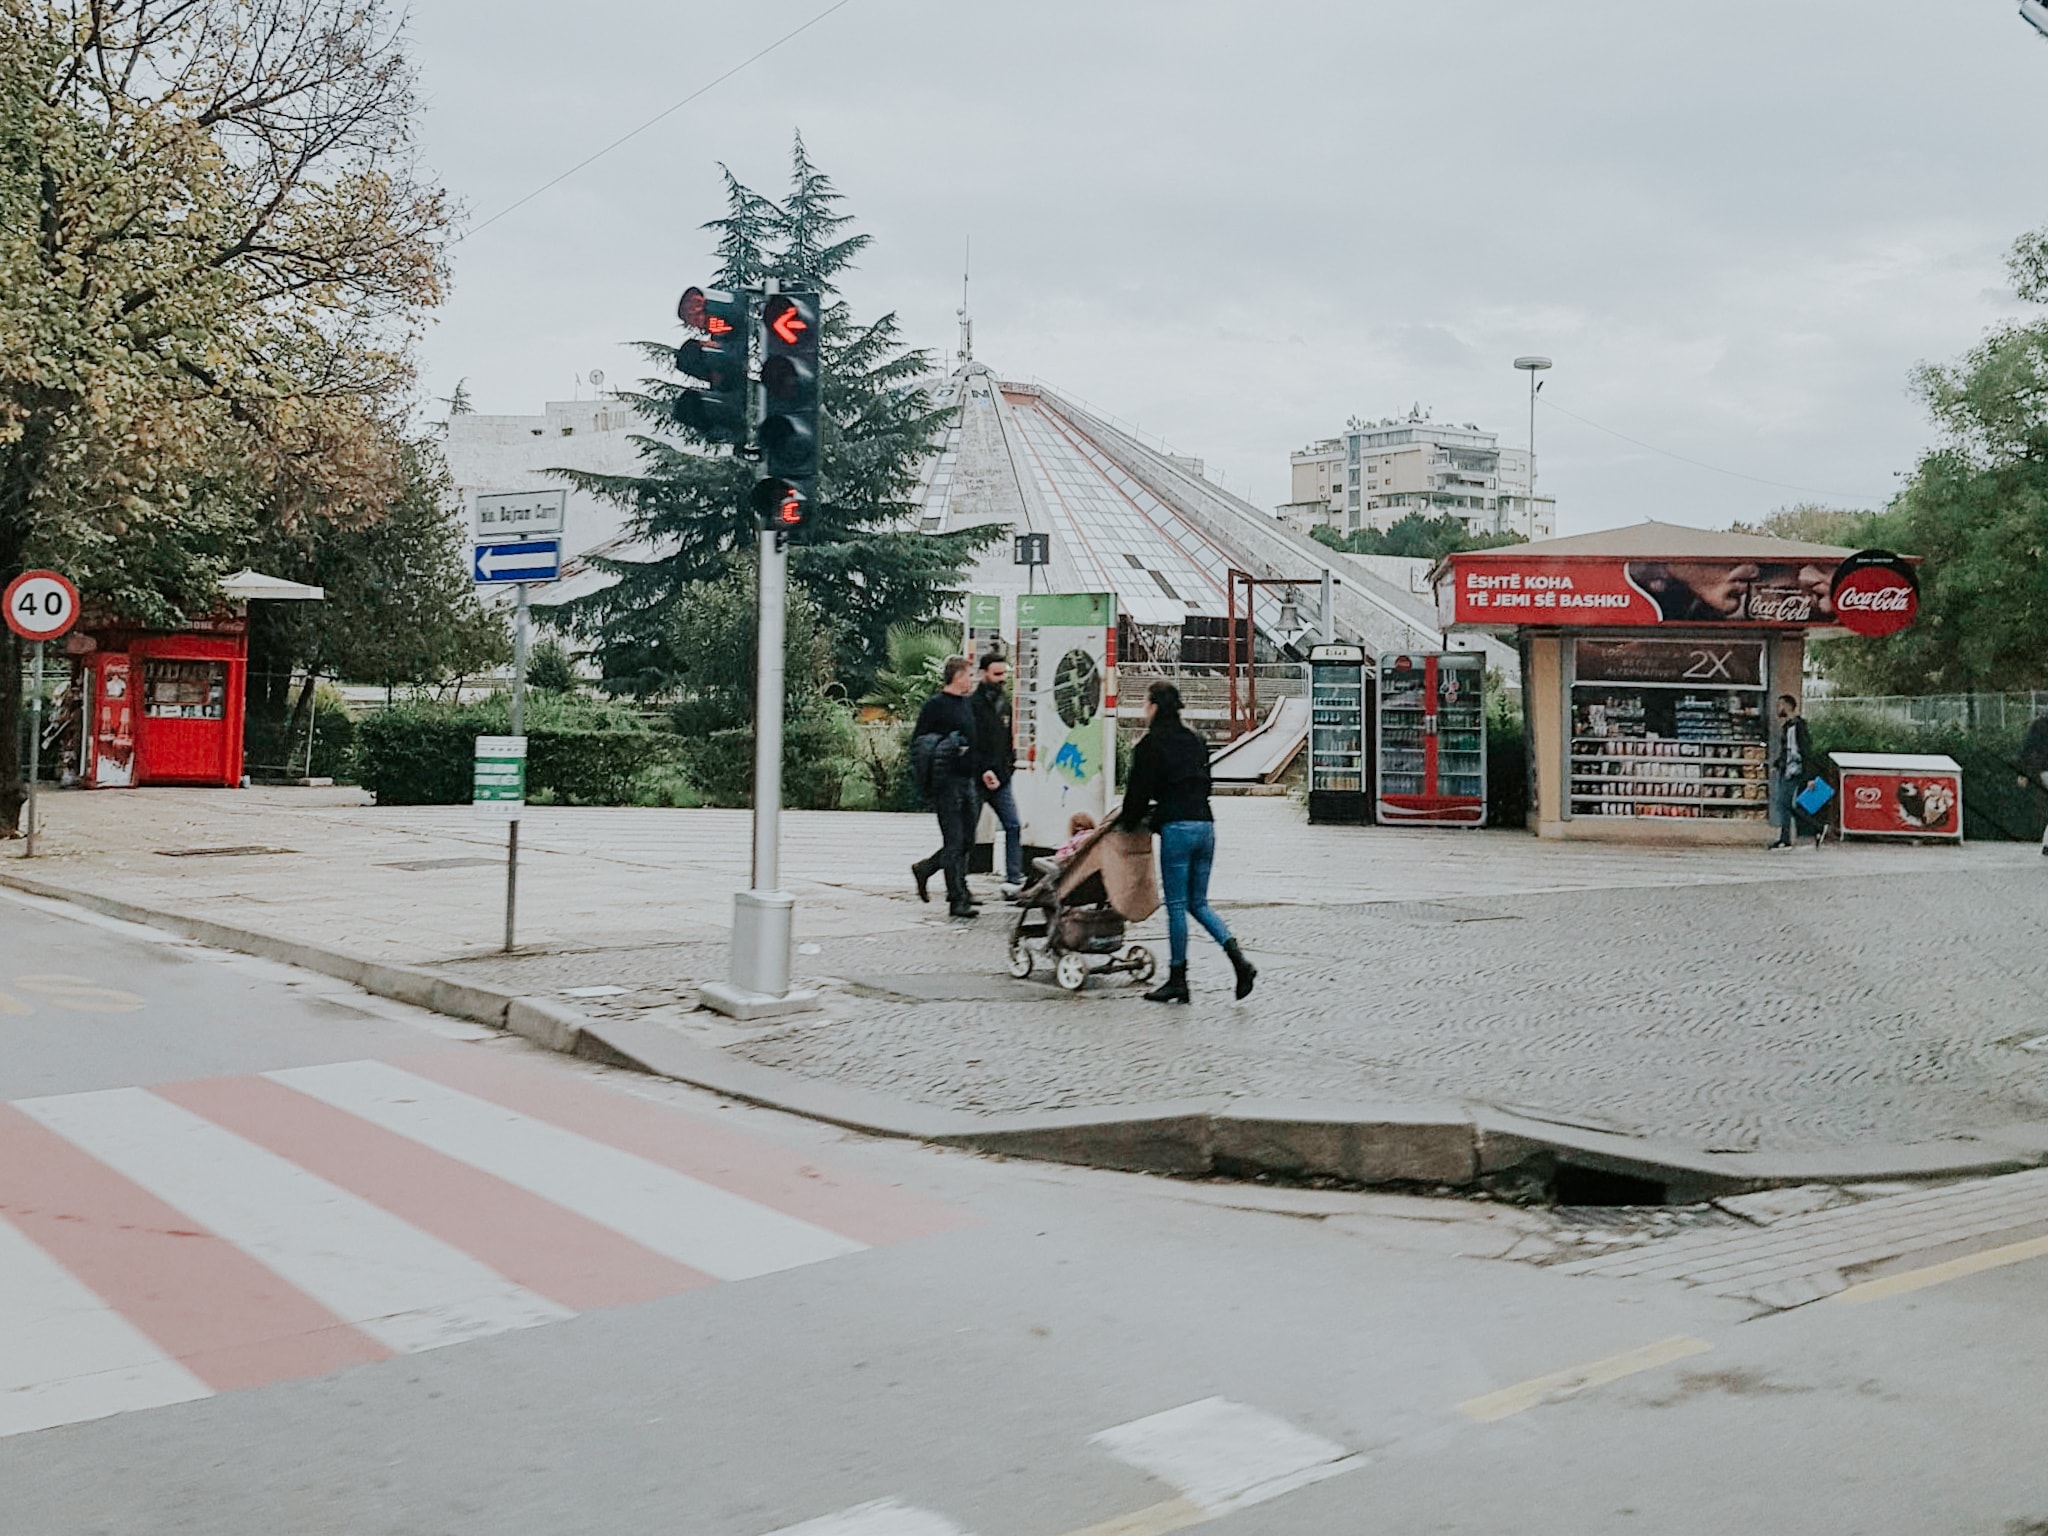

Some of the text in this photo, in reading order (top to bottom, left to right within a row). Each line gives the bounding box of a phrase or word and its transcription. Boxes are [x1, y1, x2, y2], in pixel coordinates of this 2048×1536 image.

[1467, 573, 1574, 590] ËSHTË KOHA
[18, 591, 63, 616] 40
[1466, 590, 1630, 608] TË JEMI SË BASHKU
[1748, 595, 1811, 621] Coca-Cola
[1838, 586, 1913, 611] Coca-Cola
[1682, 651, 1732, 678] 2X
